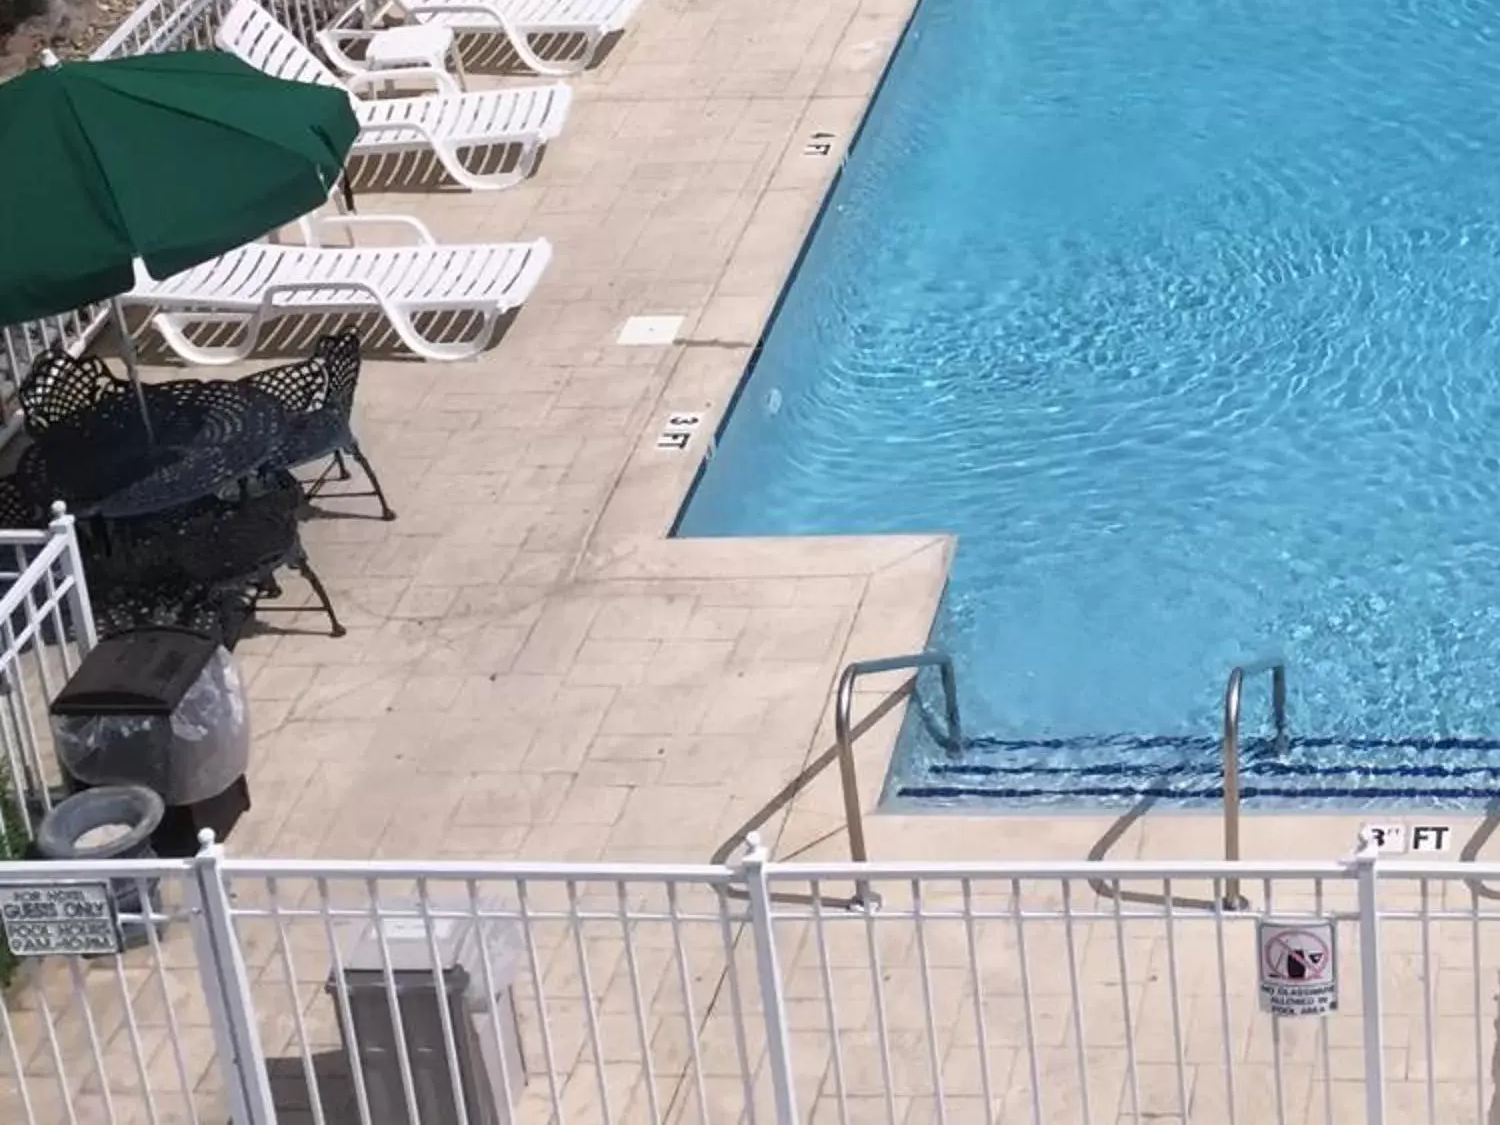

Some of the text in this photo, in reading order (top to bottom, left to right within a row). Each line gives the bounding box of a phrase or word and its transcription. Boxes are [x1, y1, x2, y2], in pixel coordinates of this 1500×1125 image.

[658, 417, 699, 449] 3 FT
[1413, 827, 1449, 849] FT
[3, 901, 106, 918] GUESTS ONLY
[8, 922, 112, 936] POOL HOURS
[1272, 1006, 1295, 1015] POOL
